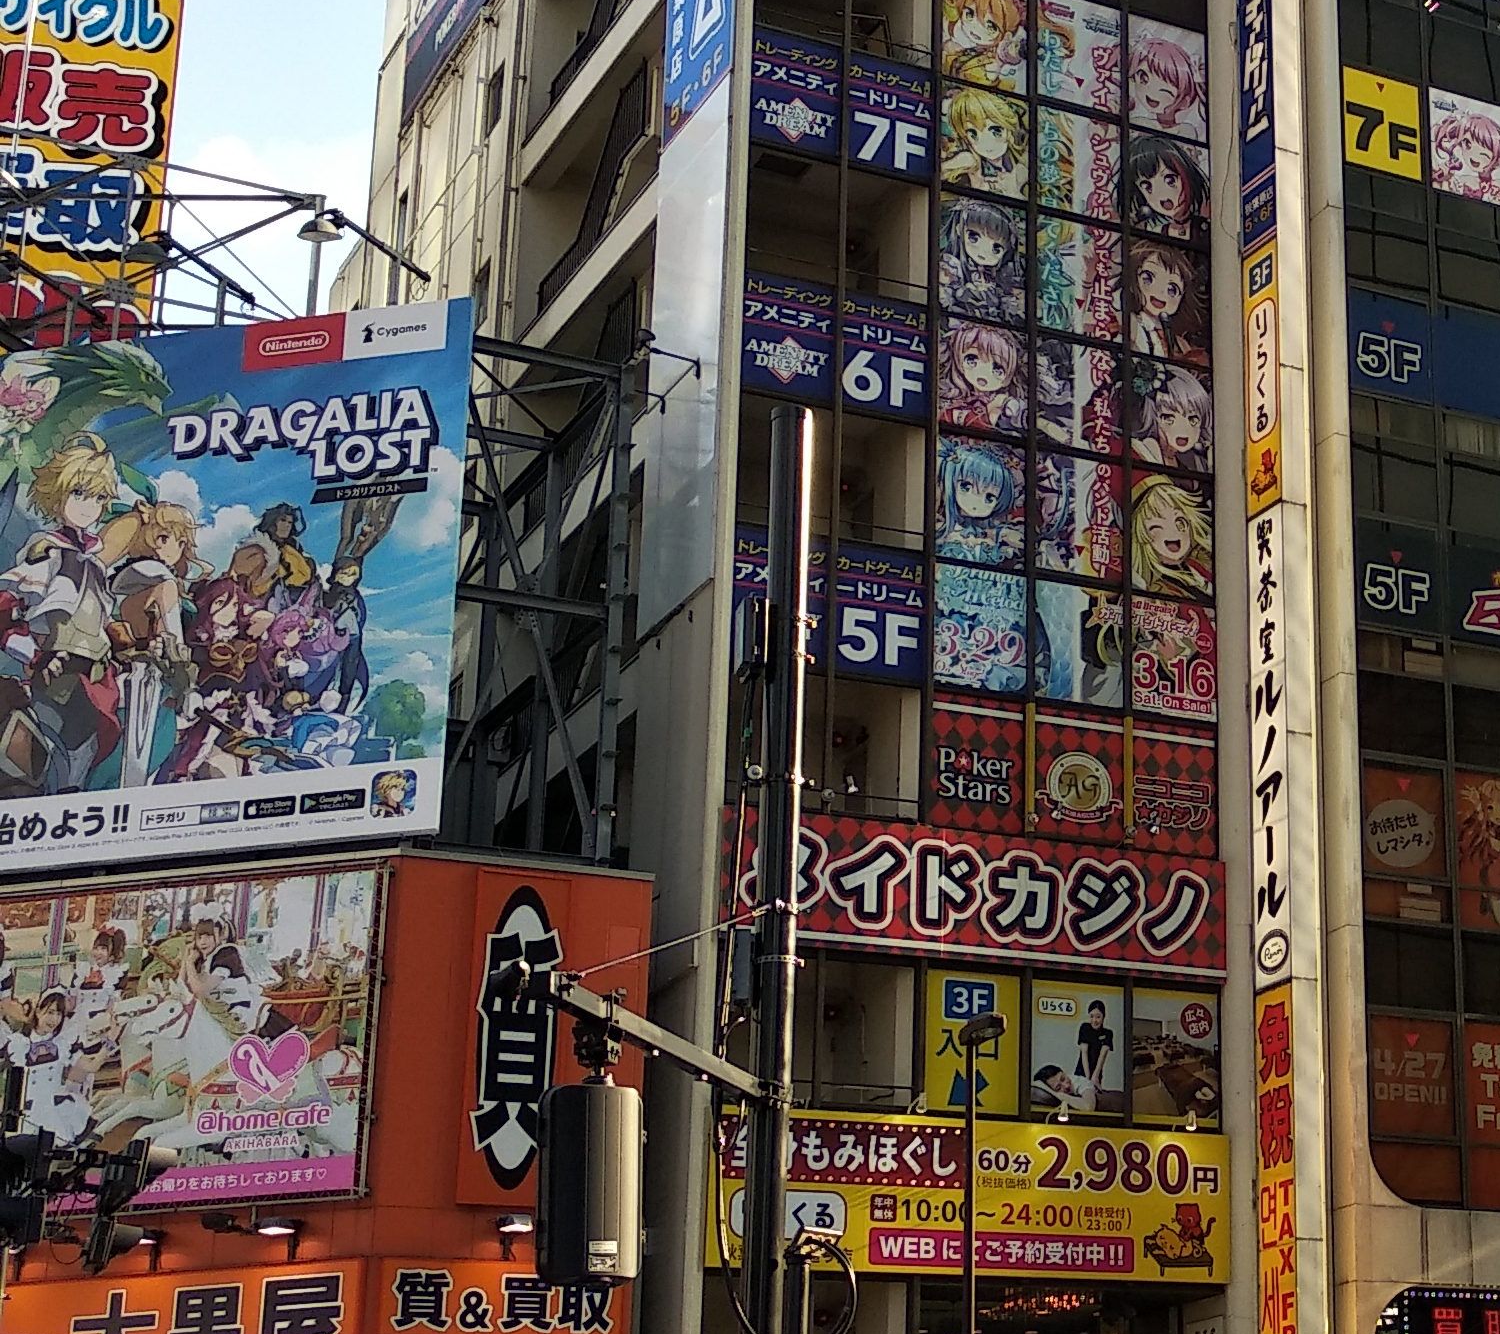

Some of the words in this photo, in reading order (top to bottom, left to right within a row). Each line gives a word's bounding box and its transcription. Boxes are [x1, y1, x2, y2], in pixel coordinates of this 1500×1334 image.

[755, 97, 836, 130] AMENITY
[764, 112, 827, 139] DREAM
[852, 111, 928, 171] 7F
[1345, 105, 1417, 161] 7F
[1251, 259, 1273, 293] 3F
[264, 334, 327, 354] Nintendo
[376, 321, 427, 340] Cygames
[744, 338, 830, 367] AMENITY
[755, 353, 820, 379] DREAM
[1357, 332, 1422, 384] 5F
[842, 350, 924, 408] 6F
[1252, 308, 1273, 434] りらくる
[168, 385, 437, 460] DRAGALIA
[311, 429, 431, 480] LOST
[1364, 564, 1430, 616] 5F
[837, 607, 919, 670] 5F
[934, 620, 1026, 666] 3.29
[1133, 651, 1215, 700] 3.16
[1163, 693, 1179, 709] On
[1182, 696, 1211, 715] Sale!
[938, 772, 1010, 805] Stars
[145, 810, 187, 826] ドラガリ
[951, 986, 991, 1014] 3F
[1039, 998, 1076, 1015] りらくる
[1373, 1048, 1447, 1080] 4/27
[1258, 1003, 1294, 1170] 免税
[197, 1108, 279, 1136] @home
[282, 1103, 333, 1131] cafe
[224, 1134, 299, 1152] AKIHABARA
[977, 1148, 1032, 1174] 60分
[1086, 1220, 1123, 1233] 23:00
[1279, 1177, 1295, 1275] TAX
[879, 1235, 936, 1261] WEB
